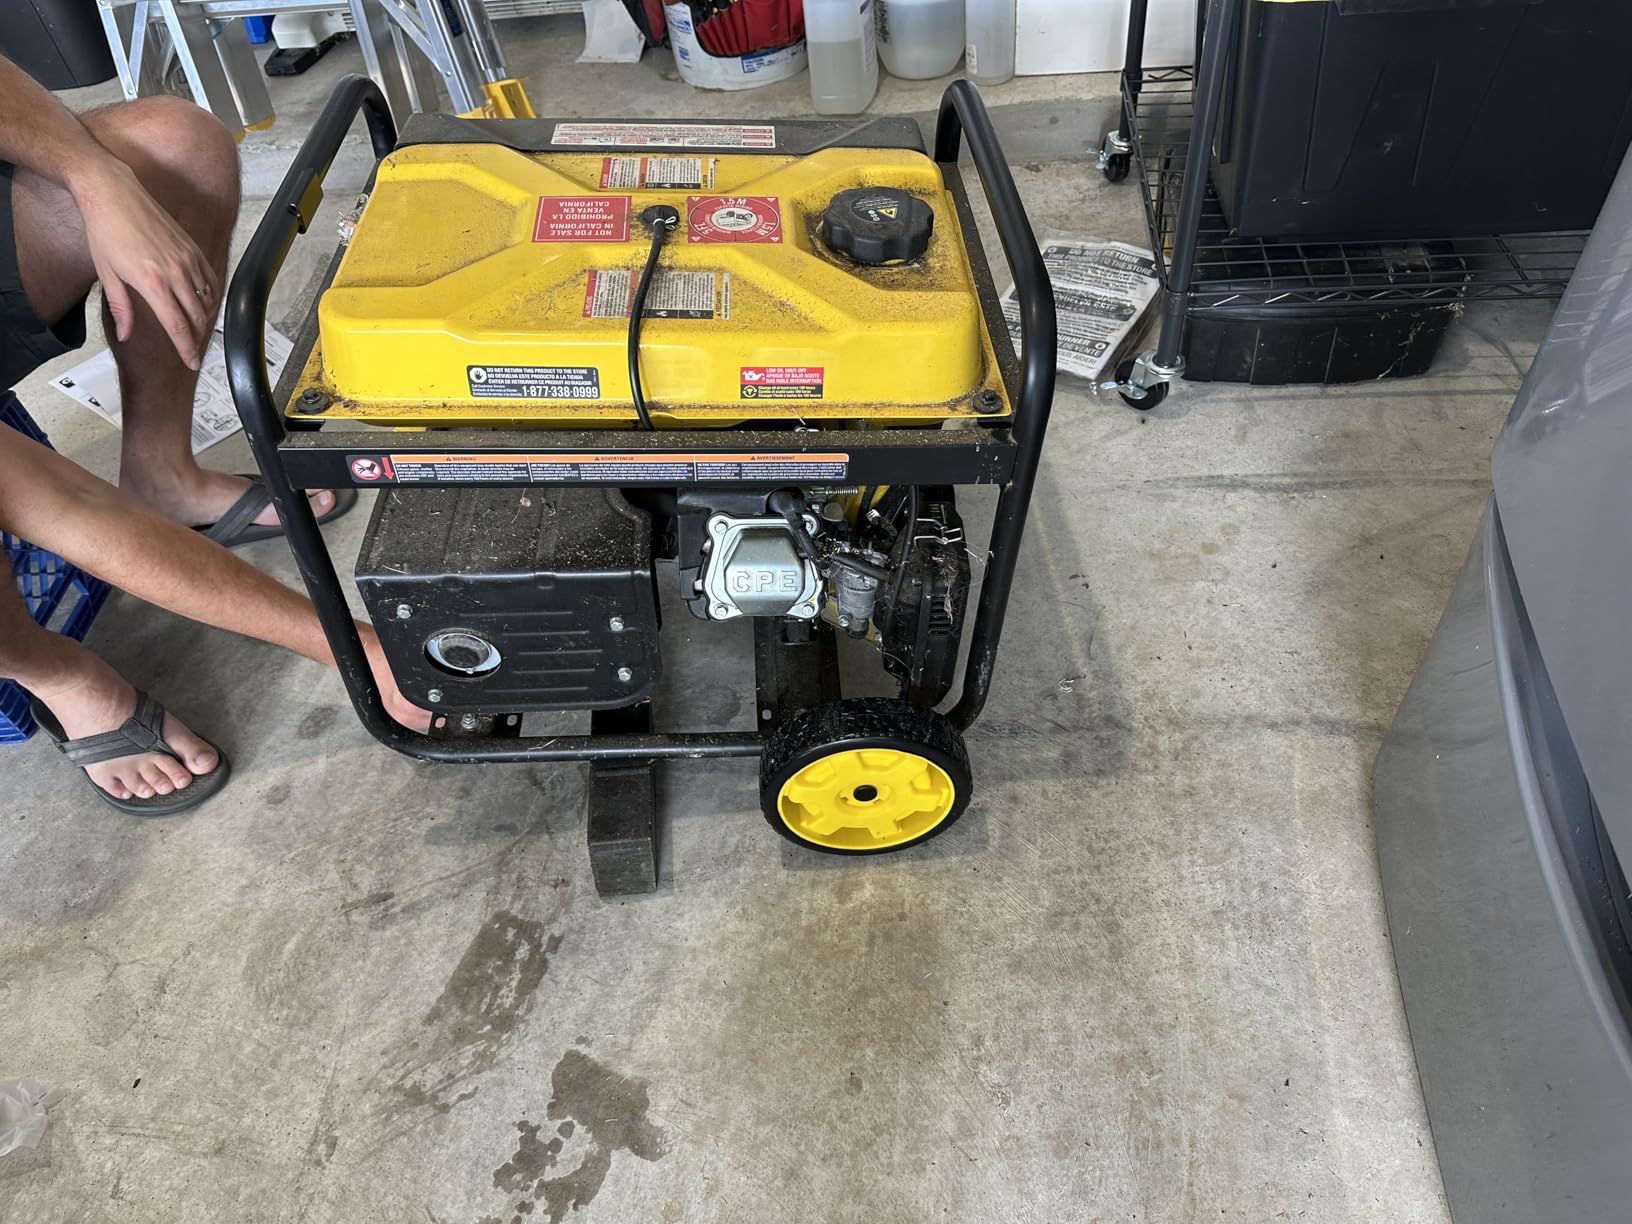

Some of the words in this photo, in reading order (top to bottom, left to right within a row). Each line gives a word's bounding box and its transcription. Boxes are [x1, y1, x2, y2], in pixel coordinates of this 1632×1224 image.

[1103, 250, 1139, 263] RETURN
[1112, 260, 1126, 268] THE
[1126, 262, 1153, 275] STORE
[522, 385, 598, 398] 1-877-338-0999
[732, 571, 798, 592] CPE
